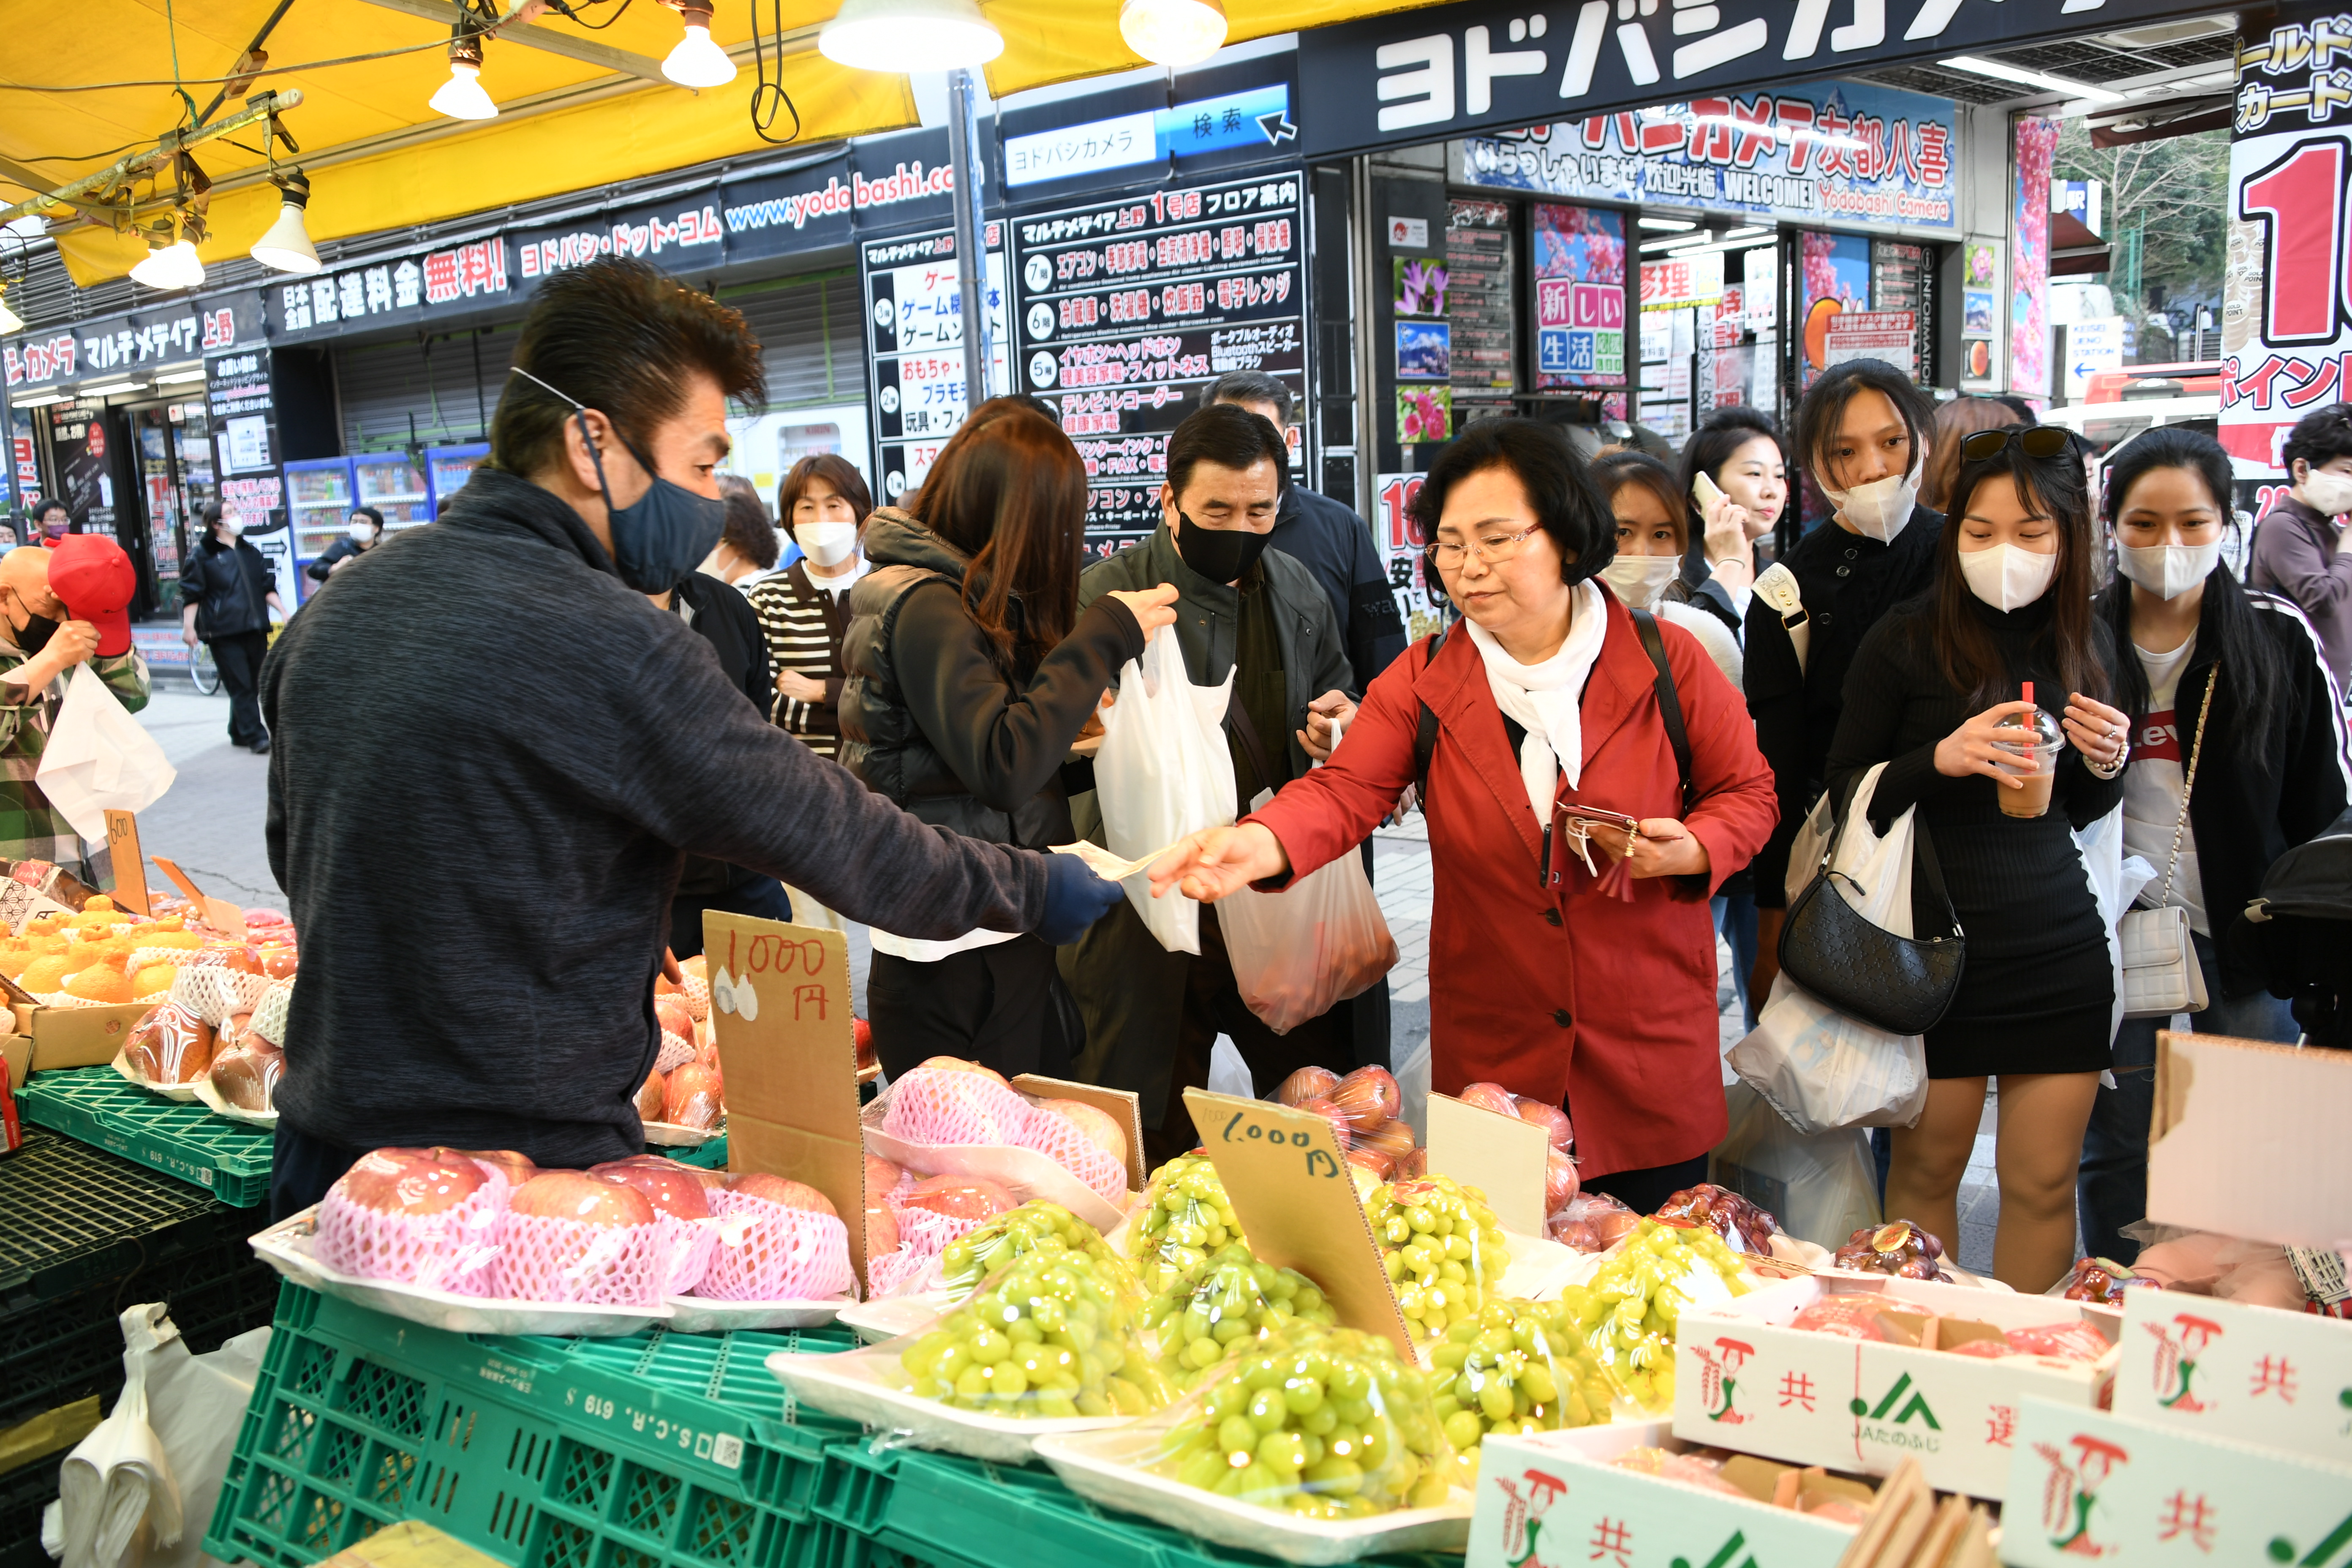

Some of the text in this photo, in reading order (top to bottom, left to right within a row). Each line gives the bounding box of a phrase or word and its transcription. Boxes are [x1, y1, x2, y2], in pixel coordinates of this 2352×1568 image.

[2235, 67, 2352, 133] カード
[1193, 107, 1241, 139] 検索
[1015, 130, 1132, 171] ヨドバシカメラ
[725, 159, 984, 232] www.yodobashi.co
[1206, 180, 1297, 214] フロア案内
[1723, 170, 1814, 209] WELCOME!
[1817, 179, 1949, 222] Yodobashi Camera
[2066, 190, 2085, 210] 駅
[2240, 135, 2352, 348] 1
[1542, 284, 1622, 324] 新しい
[1211, 323, 1295, 345] ポータブルオーディオ
[2074, 324, 2106, 332] KEISEI
[3, 308, 234, 387] シカメラ マルチメディア 上野
[1059, 336, 1181, 366] イヤホン・ヘッドホン
[1211, 338, 1301, 358] Bluetoothスピーカー
[1543, 334, 1592, 368] 生活
[2074, 348, 2115, 357] STATION
[1061, 385, 1183, 414] テレビ・レコーダー
[109, 812, 128, 845] 600
[792, 983, 829, 1021] 円
[1777, 1370, 1816, 1413] 共
[2248, 1353, 2299, 1407] 共
[584, 1394, 615, 1421] 619
[1851, 1424, 1941, 1453] JAたのふじ
[2157, 1488, 2218, 1555] 共
[1588, 1515, 1634, 1568] 共
